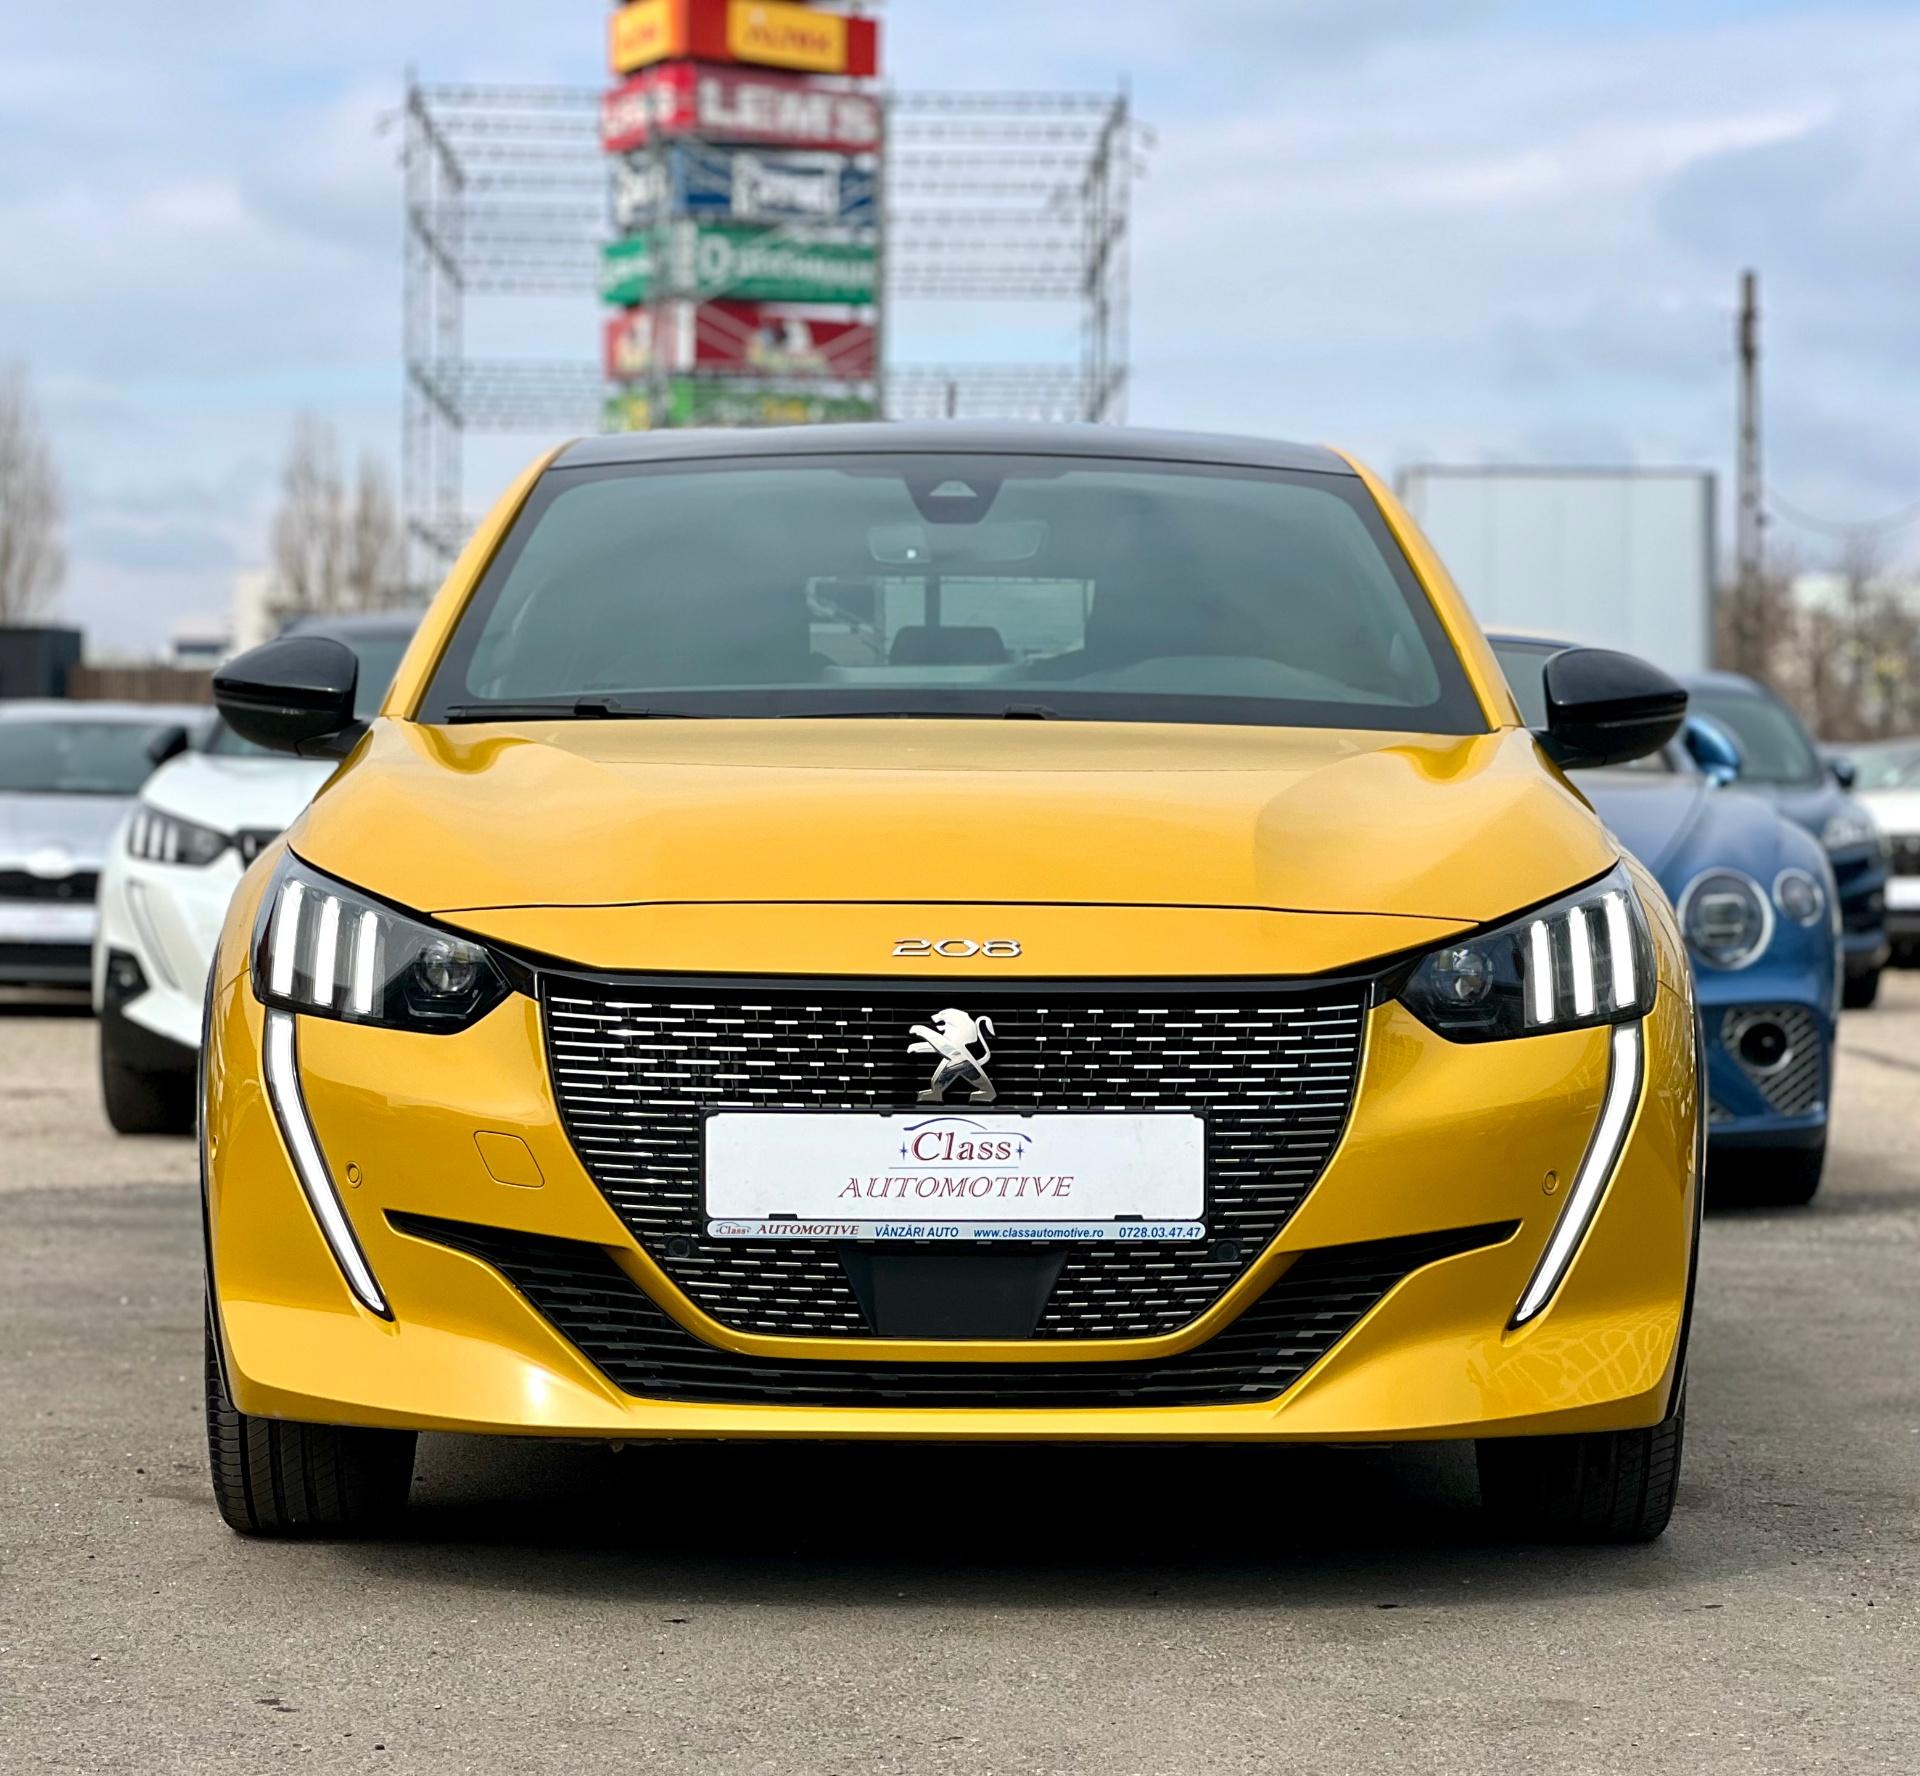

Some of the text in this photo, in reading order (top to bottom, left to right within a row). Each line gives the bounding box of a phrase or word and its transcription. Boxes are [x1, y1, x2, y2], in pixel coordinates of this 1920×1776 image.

[891, 938, 1022, 957] 208
[911, 1131, 1012, 1161] Class
[838, 1176, 1074, 1198] AUTOMOTIVE
[756, 1224, 860, 1235] AUTOMOTIVE
[874, 1223, 925, 1238] VÂNZĂRI
[927, 1226, 959, 1238] AUTO
[974, 1227, 1104, 1239] www.classautomotive.ro
[1119, 1227, 1201, 1239] 0728.03.47.47
